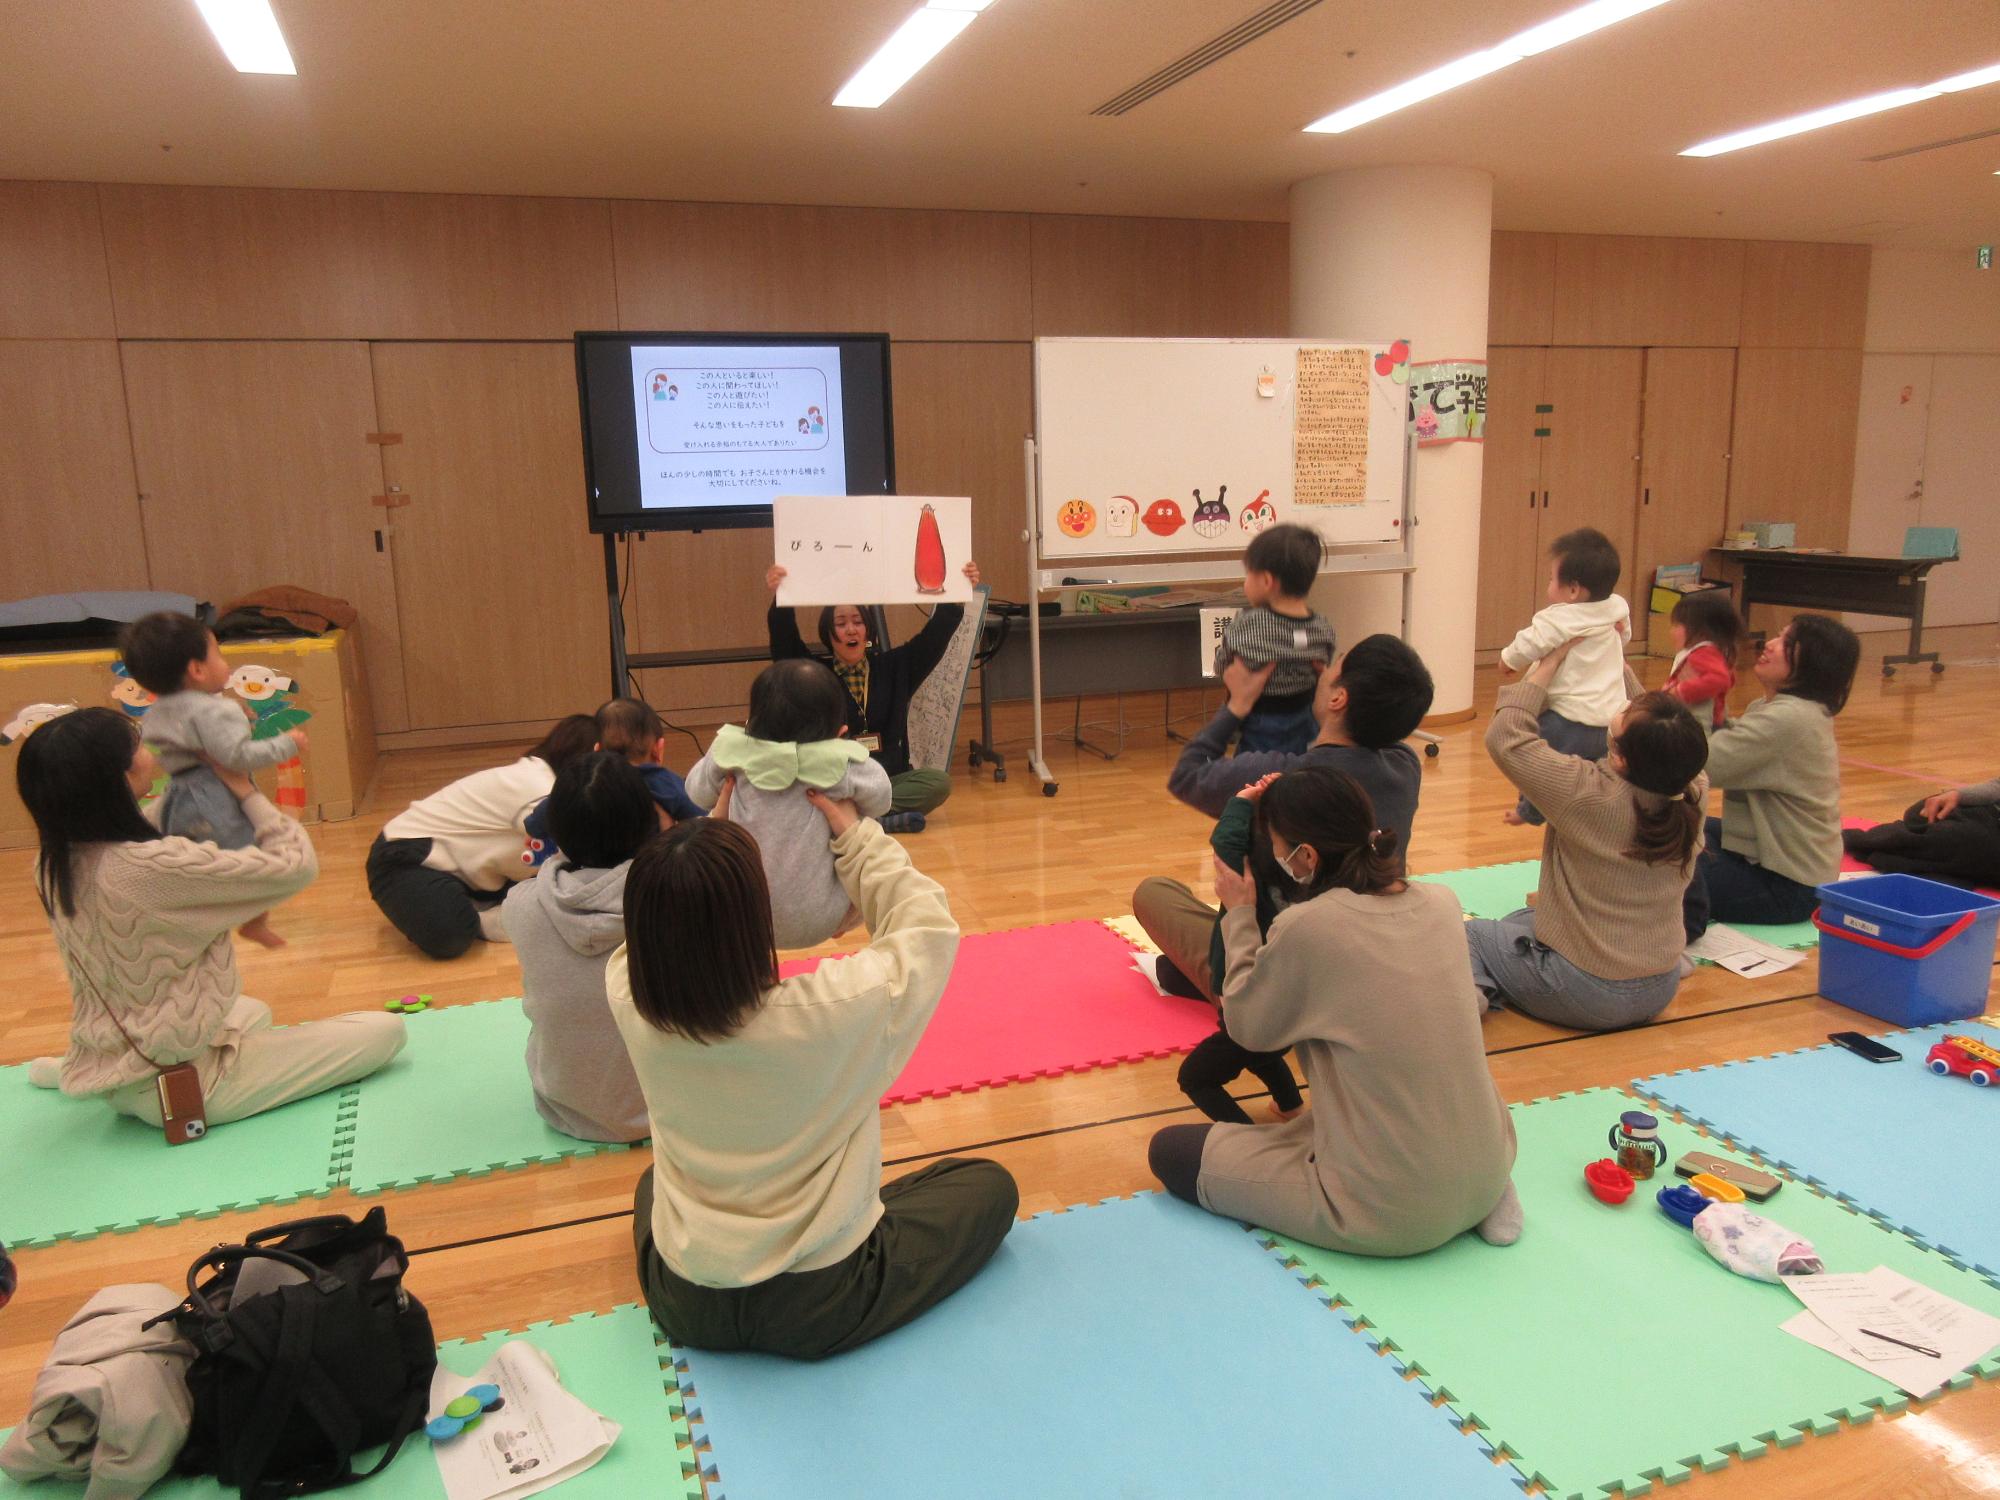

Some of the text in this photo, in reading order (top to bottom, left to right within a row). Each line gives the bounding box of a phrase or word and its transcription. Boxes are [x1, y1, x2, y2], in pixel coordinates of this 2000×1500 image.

[660, 468, 736, 479] ほんの少しの時間でも
